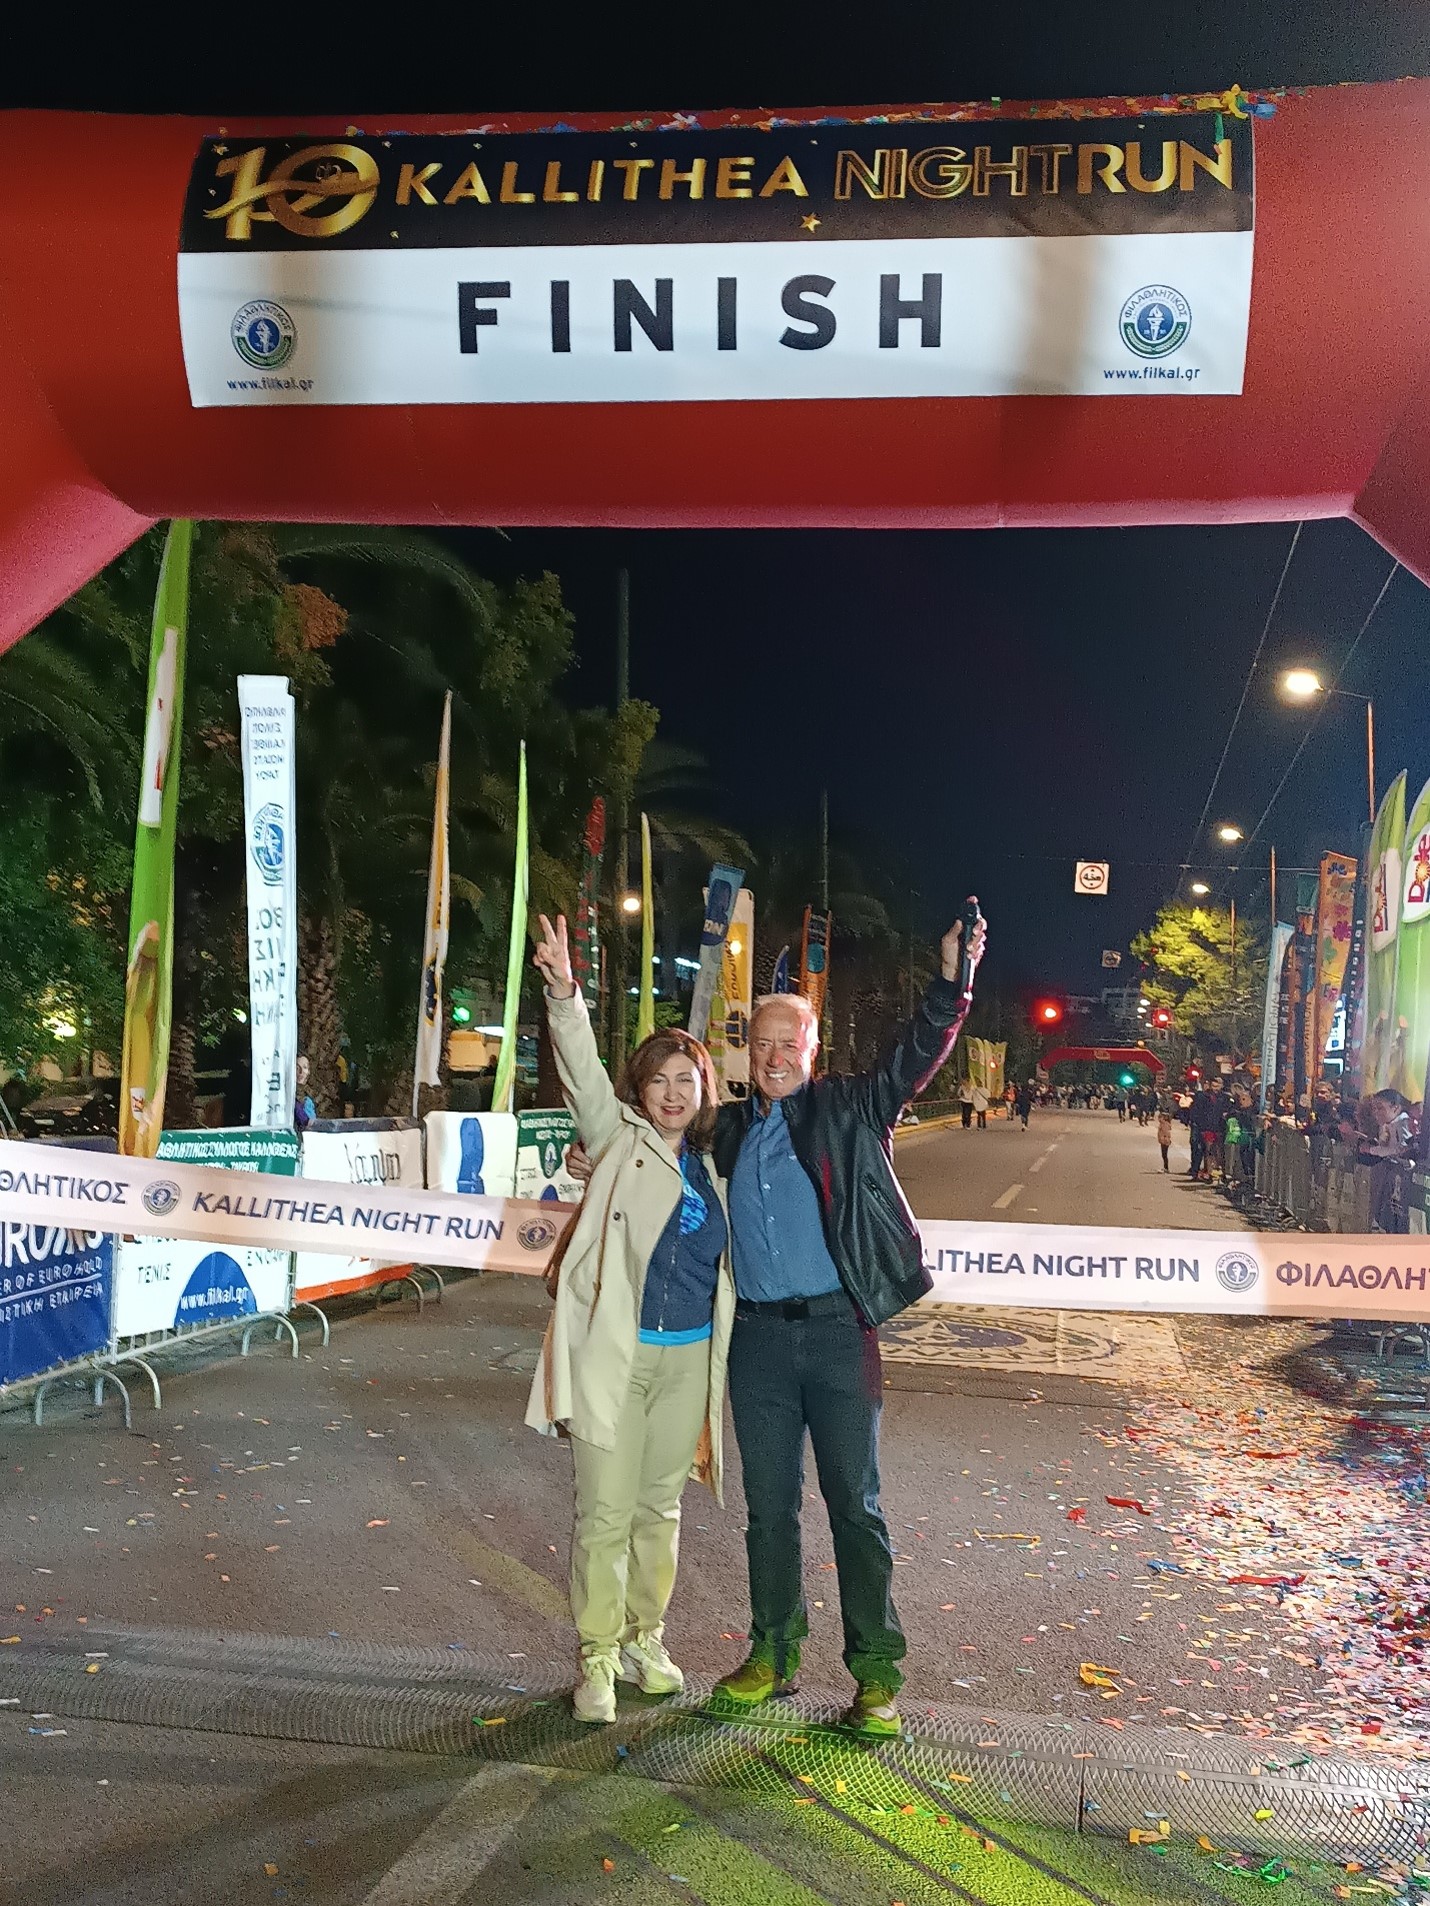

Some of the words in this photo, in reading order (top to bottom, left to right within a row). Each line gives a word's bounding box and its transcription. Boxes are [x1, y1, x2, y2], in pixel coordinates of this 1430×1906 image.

[396, 157, 809, 205] KALLITHEA
[457, 273, 942, 354] FINISH
[1124, 288, 1188, 318] ΦΙΛΑΘΛΗΤΙΚΟΣ
[226, 377, 315, 392] www.filkal.gr
[1103, 366, 1201, 381] www.filkal.gr
[192, 1192, 343, 1225] KALLITHEA
[351, 1207, 440, 1235] NIGHT
[445, 1217, 504, 1241] RUN
[15, 1272, 35, 1291] OF
[1033, 1254, 1128, 1280] NIGHT
[1135, 1259, 1200, 1282] RUN
[1276, 1260, 1430, 1290] ΦΙΛΑΘΛΗ
